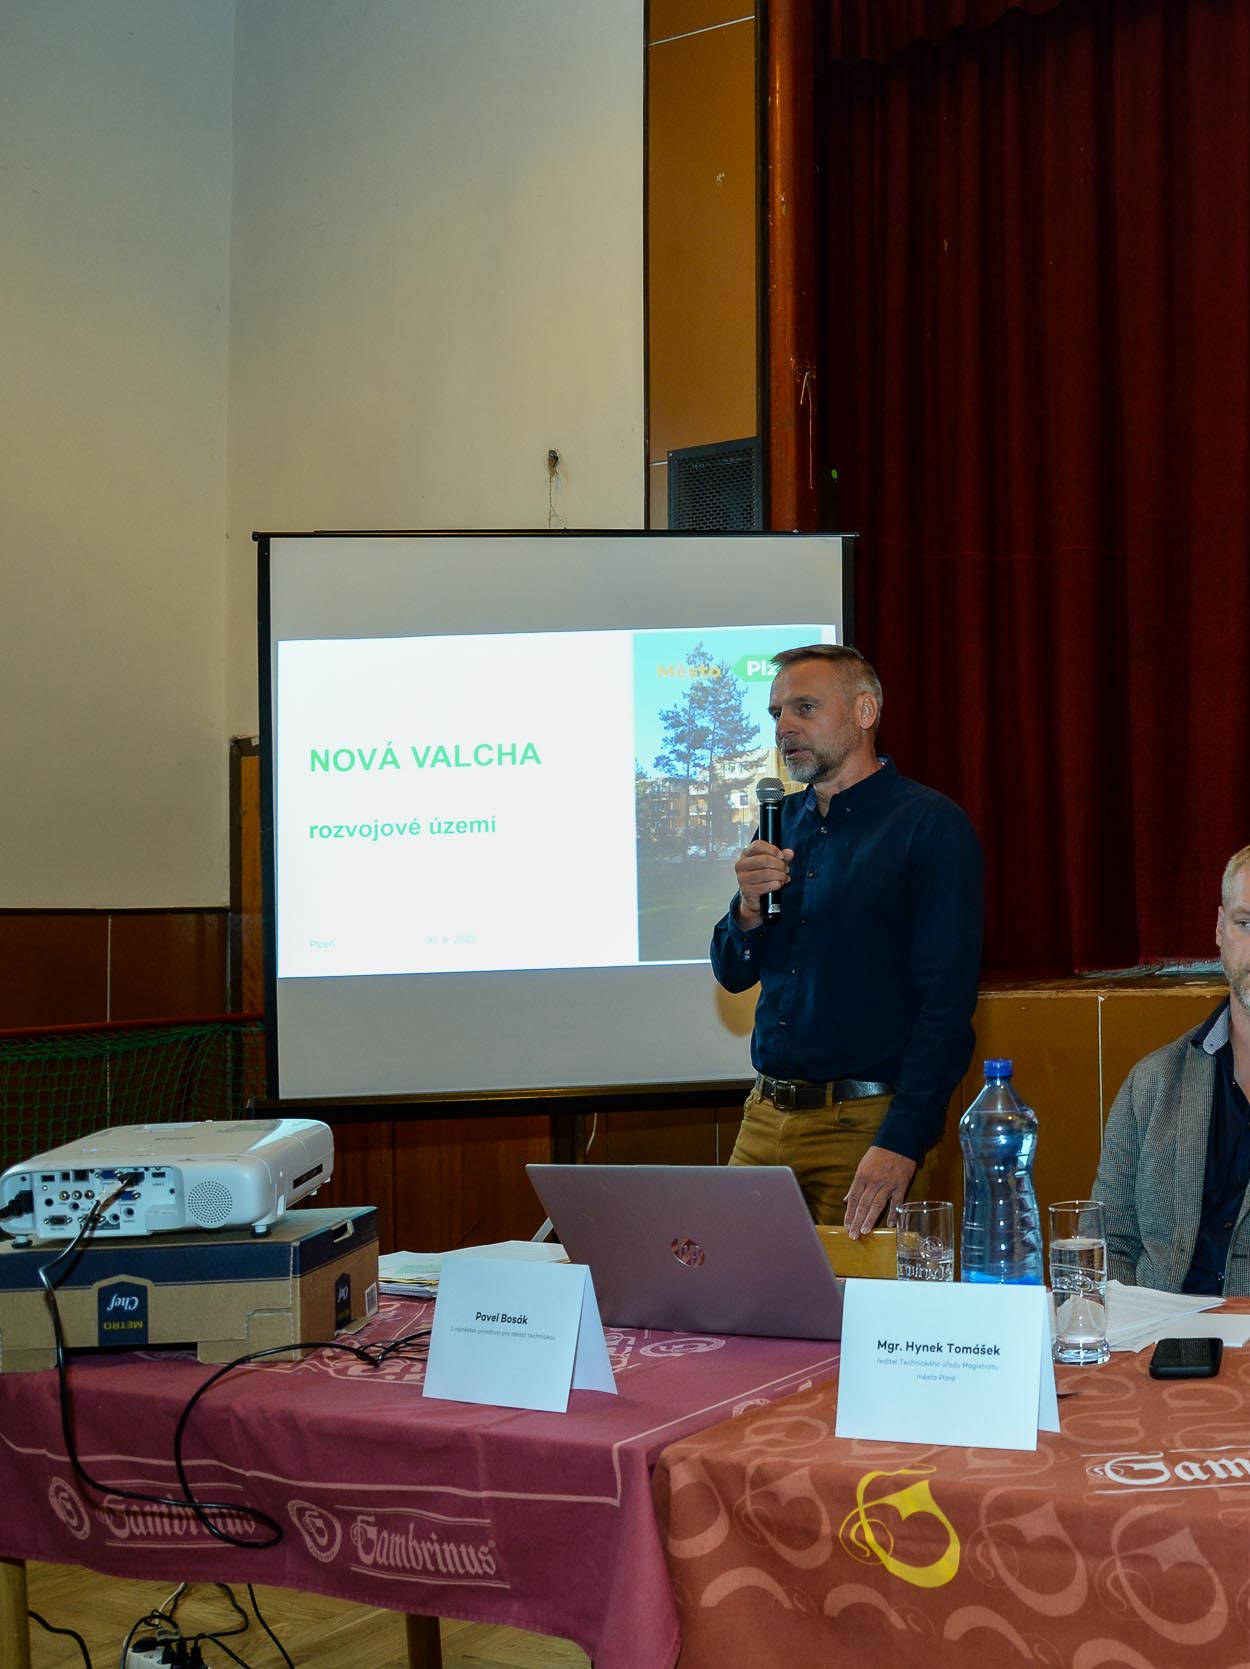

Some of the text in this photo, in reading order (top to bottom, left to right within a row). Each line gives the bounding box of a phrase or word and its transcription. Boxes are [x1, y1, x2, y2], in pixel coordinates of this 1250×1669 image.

[746, 660, 781, 677] Plz
[310, 741, 542, 773] NOVÁ VALCHA
[309, 815, 497, 842] rozvojové území
[106, 1292, 139, 1312] Chef
[103, 1320, 143, 1331] METRO
[475, 1311, 528, 1325] Pavel Bosák
[877, 1340, 1001, 1356] Mgr. Hynek Tomášek
[350, 1514, 497, 1576] Gambrinus
